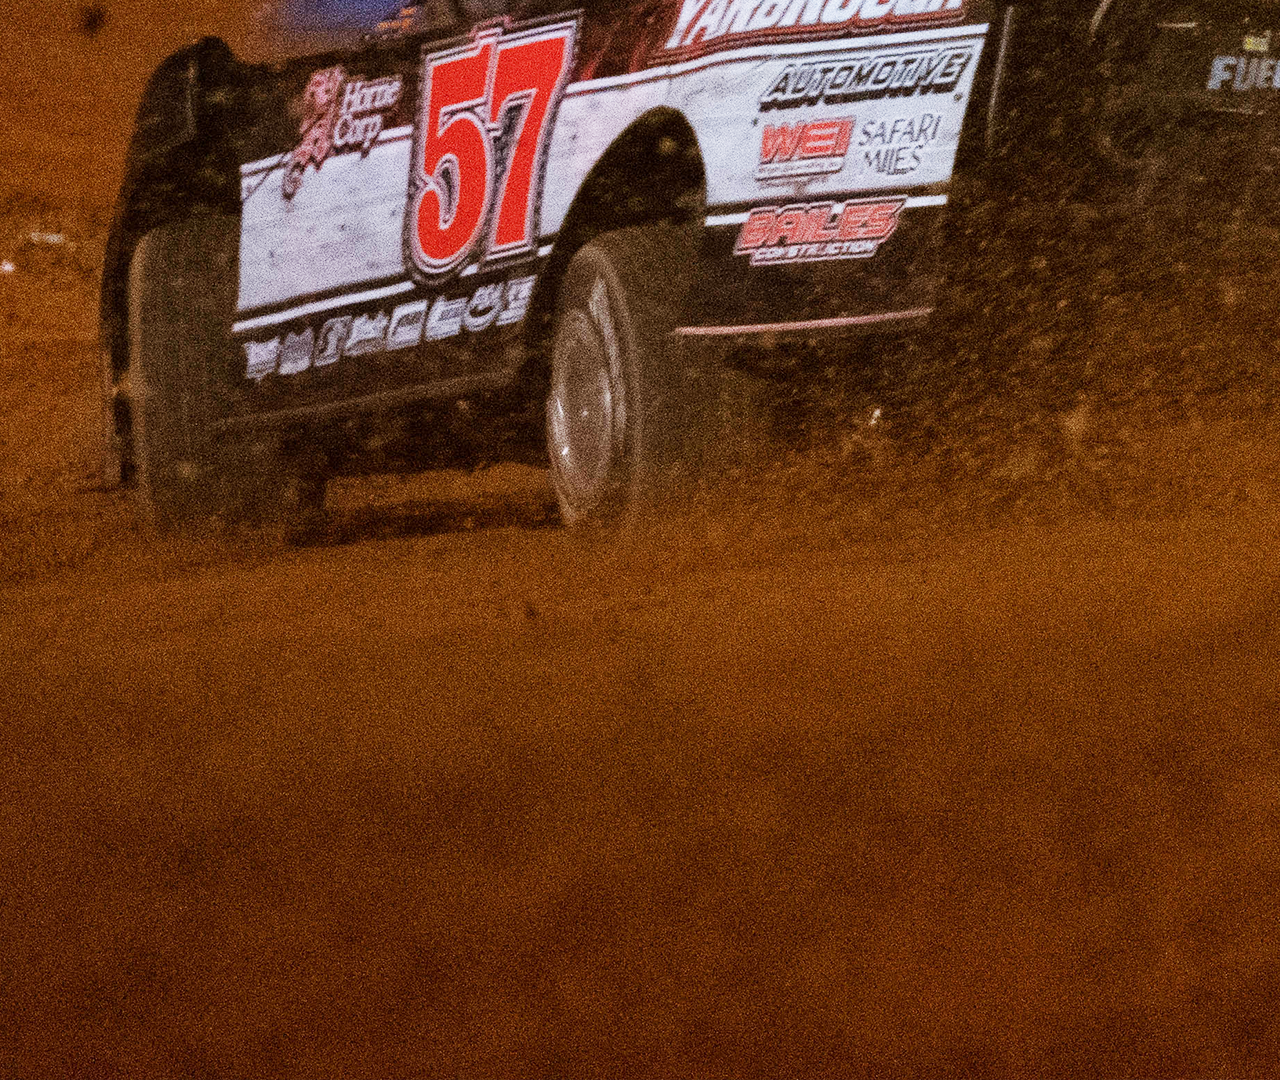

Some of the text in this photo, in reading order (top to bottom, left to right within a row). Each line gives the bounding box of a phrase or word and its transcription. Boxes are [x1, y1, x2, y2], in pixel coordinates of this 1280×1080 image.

[759, 48, 974, 111] AUTOMOTIVE
[333, 112, 386, 150] Corp
[410, 18, 577, 275] 57
[858, 112, 943, 148] SAFARI
